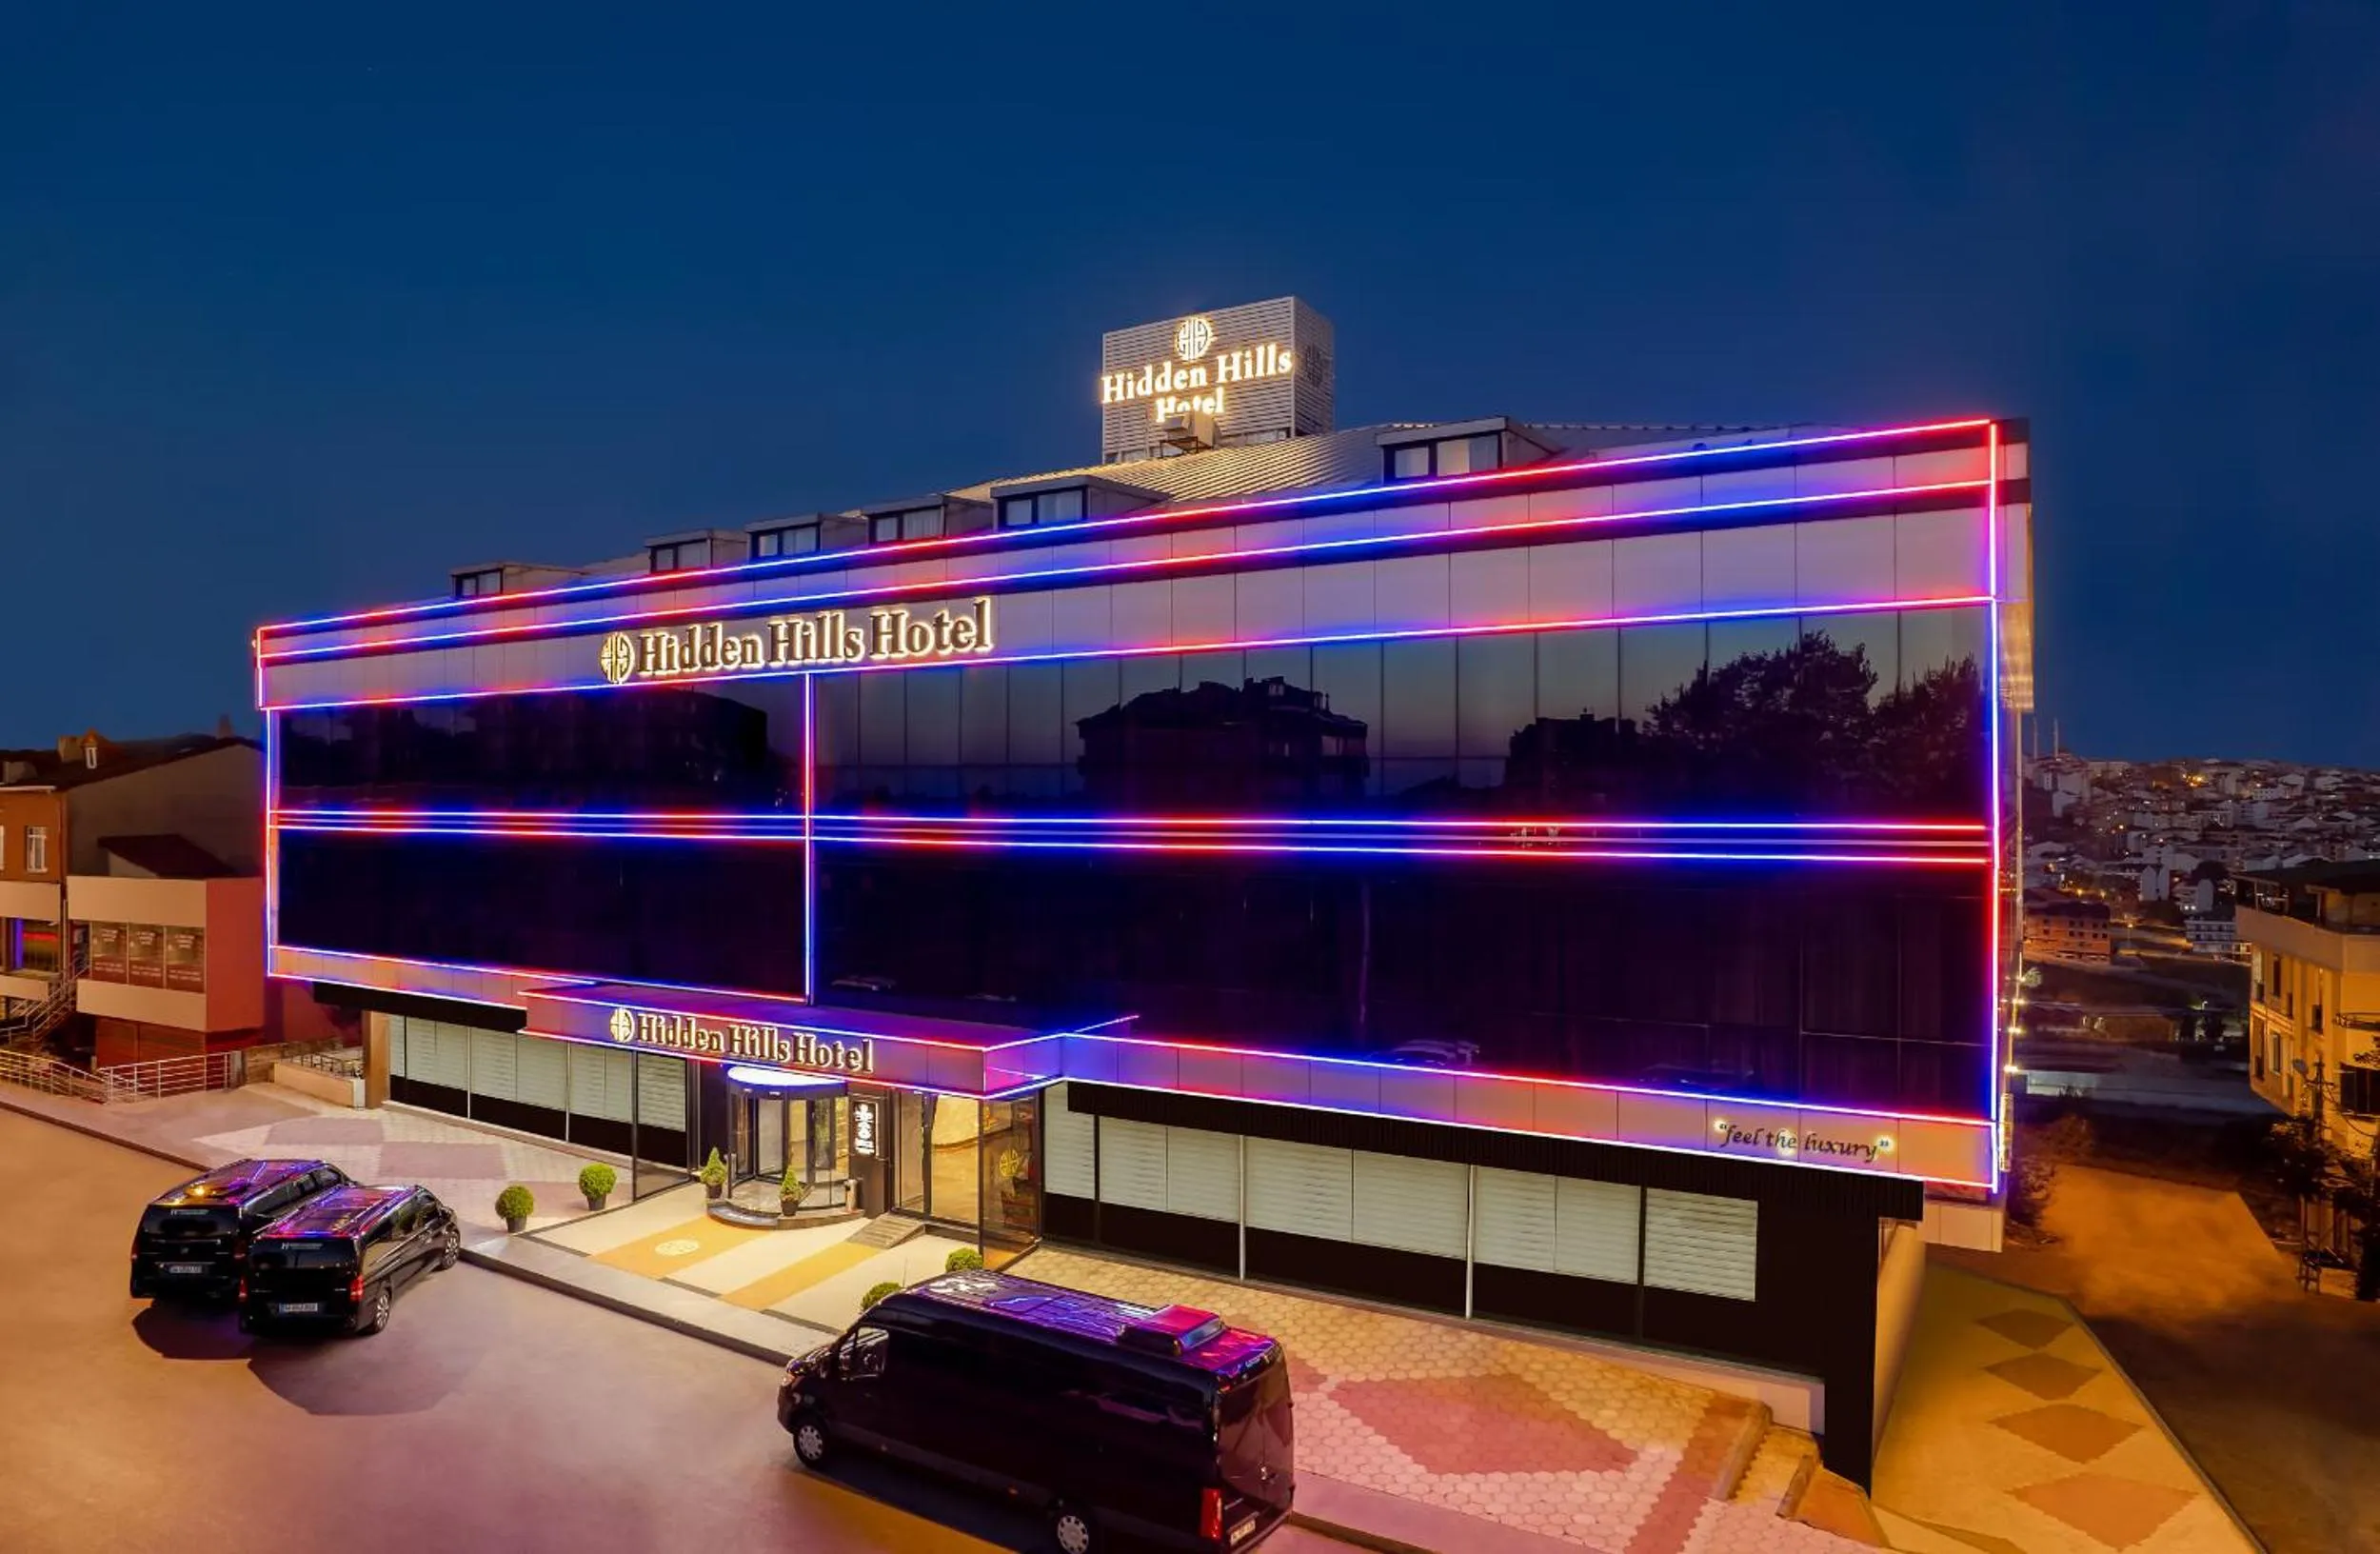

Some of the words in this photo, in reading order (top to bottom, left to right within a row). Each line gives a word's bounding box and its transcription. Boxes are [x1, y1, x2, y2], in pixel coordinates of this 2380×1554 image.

[1101, 361, 1208, 404] Hidden
[1216, 344, 1294, 383] Hills
[637, 623, 760, 675] Hidden
[765, 610, 864, 665] Hills
[869, 597, 993, 657] Hotel
[637, 1013, 724, 1053] Hidden
[727, 1025, 790, 1062] Hills
[792, 1032, 874, 1073] Hotel
[1766, 1129, 1797, 1149] the
